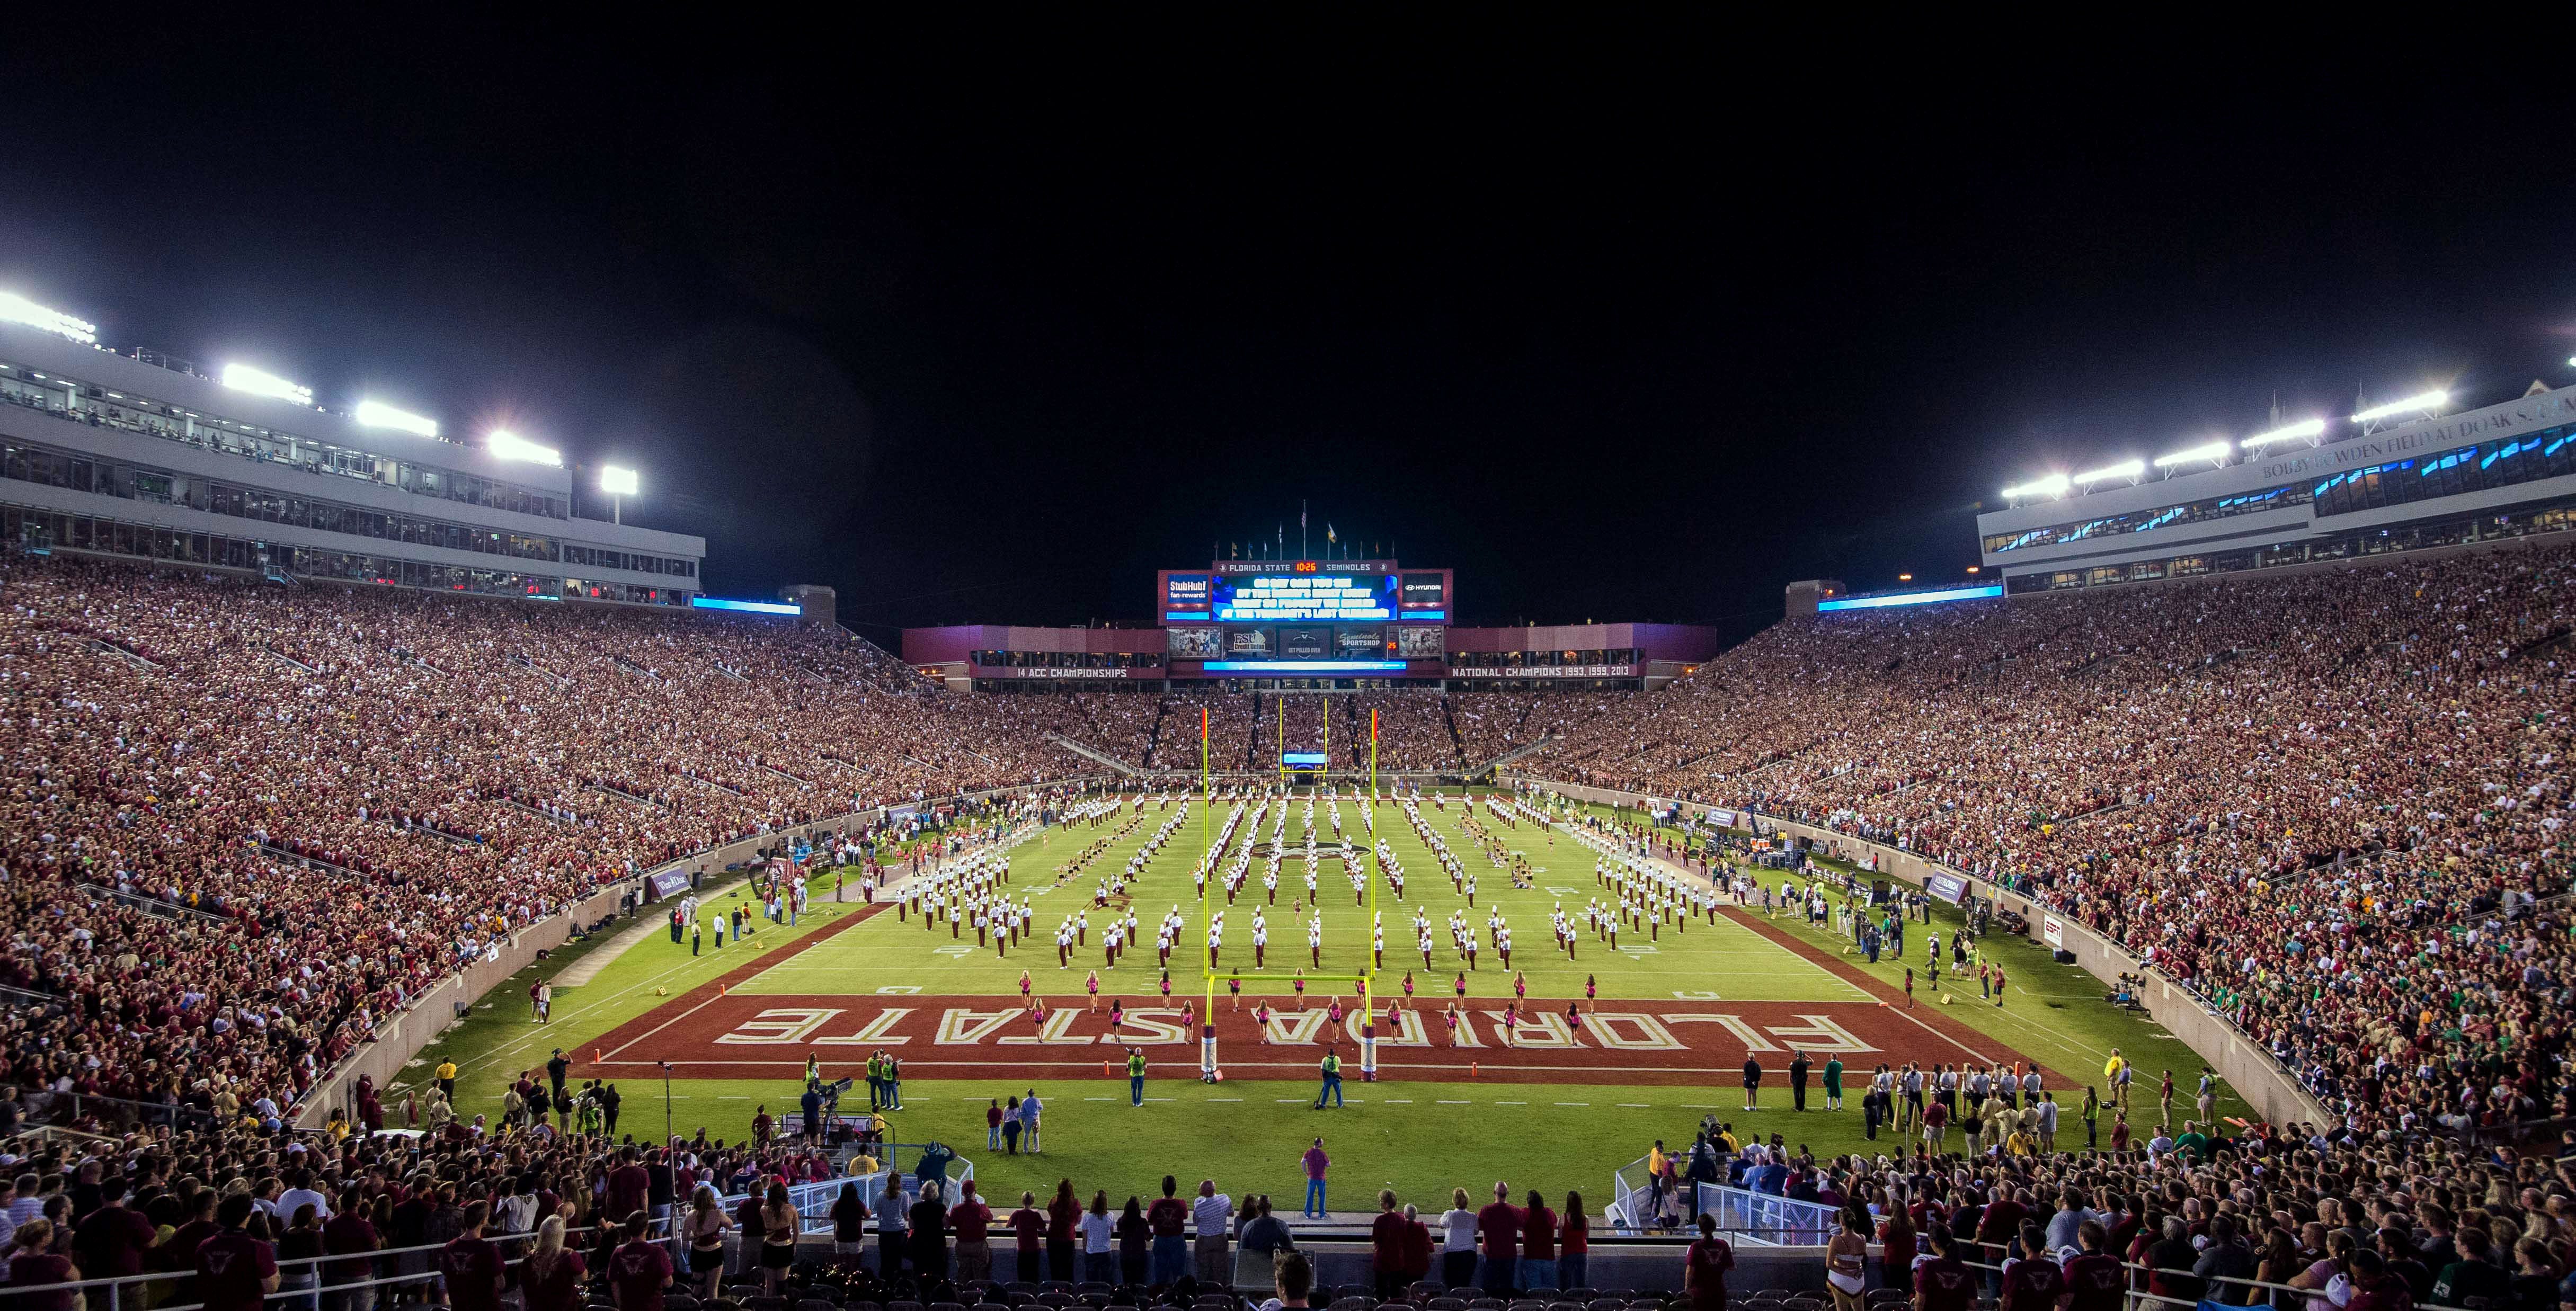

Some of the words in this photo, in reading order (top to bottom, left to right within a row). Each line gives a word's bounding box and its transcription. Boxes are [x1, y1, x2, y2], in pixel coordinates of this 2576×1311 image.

[2263, 457, 2309, 478] BOBBY
[2315, 442, 2383, 467] BOWDEN
[2388, 431, 2433, 452] FIELD
[2436, 425, 2454, 441] AT
[2459, 414, 2511, 436] DOAK
[1296, 563, 1316, 571] 10:26
[1170, 581, 1206, 591] StubHub!
[1234, 634, 1256, 644] FSU
[1018, 668, 1025, 677] 14
[1028, 668, 1046, 677] ACC
[1051, 668, 1127, 677] CHAMPIONSHIPS
[1452, 668, 1501, 677] NATIONAL
[1506, 668, 1561, 676] CHAMPIONS
[1566, 667, 1586, 676] 1993,
[1589, 667, 1609, 676] 1999,
[1611, 666, 1629, 675] 2013
[2046, 921, 2060, 938] ESPN
[713, 1009, 1188, 1045] STATE
[1251, 1008, 1885, 1053] FLORIDA
